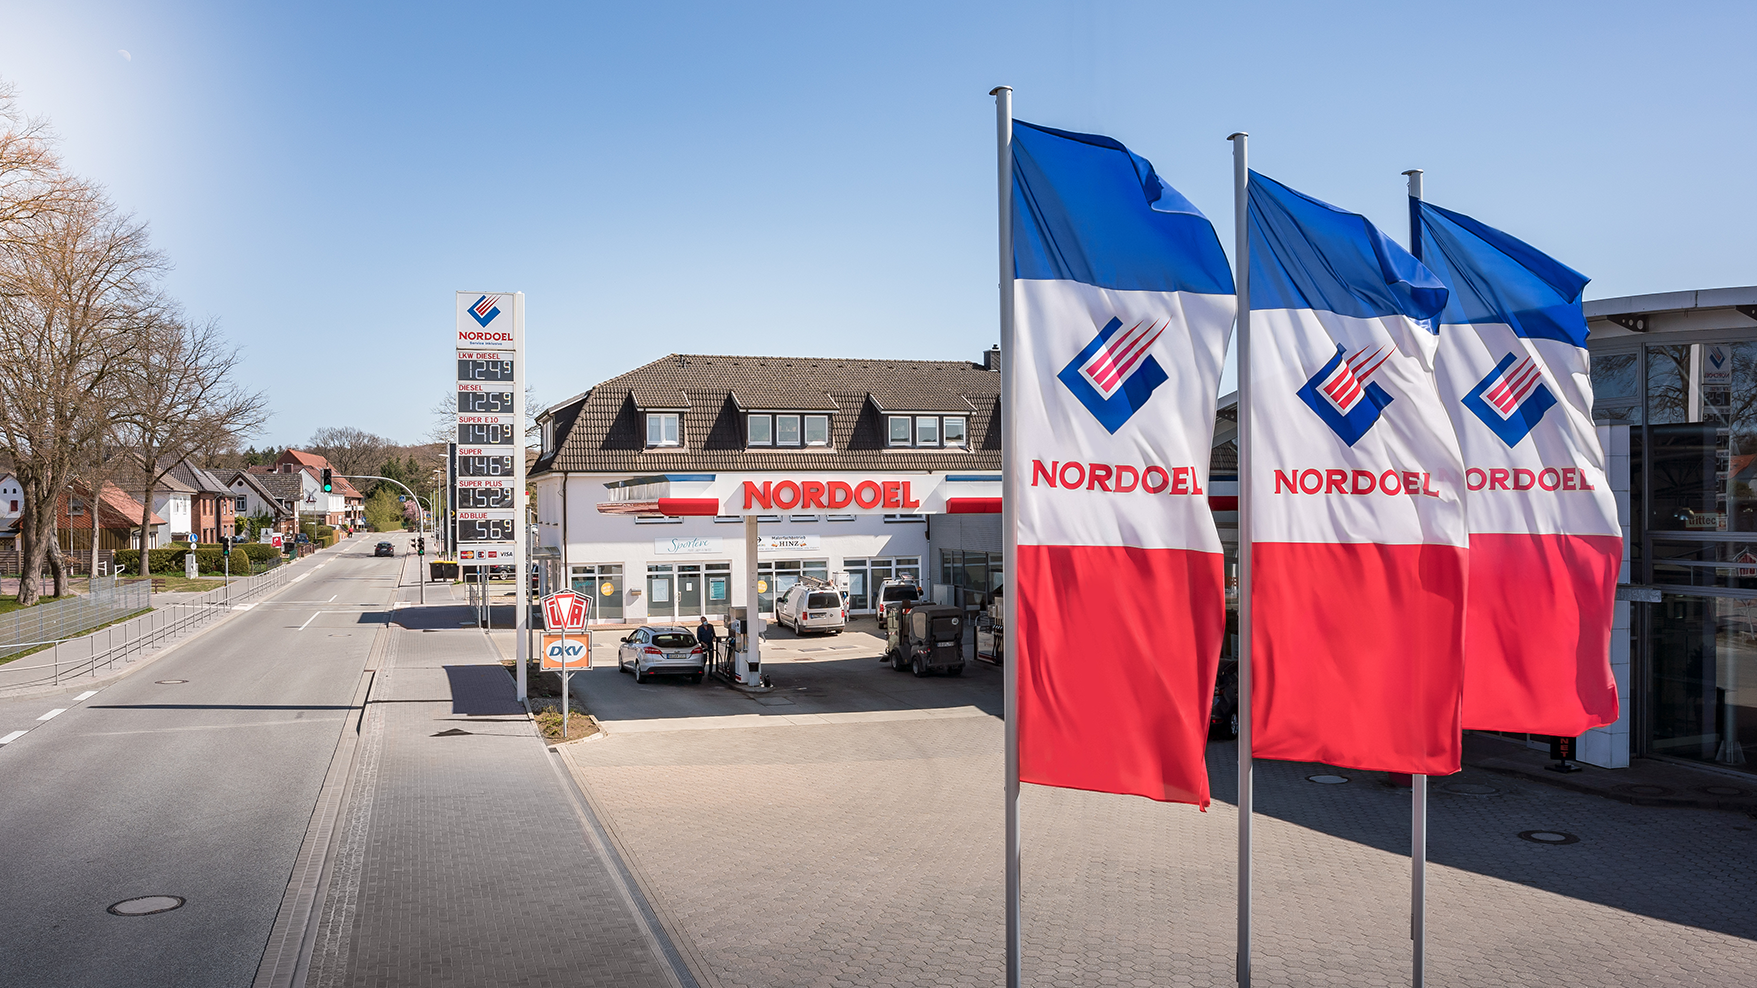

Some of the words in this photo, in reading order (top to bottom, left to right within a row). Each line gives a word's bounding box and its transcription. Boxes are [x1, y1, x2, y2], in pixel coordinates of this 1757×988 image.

[459, 331, 513, 341] NORDOEL
[458, 416, 482, 424] SUPER
[1031, 459, 1203, 495] NORDOEL
[1274, 467, 1440, 497] NORDOEL
[1465, 467, 1595, 492] ORDOEL
[743, 480, 920, 509] NORDOEL
